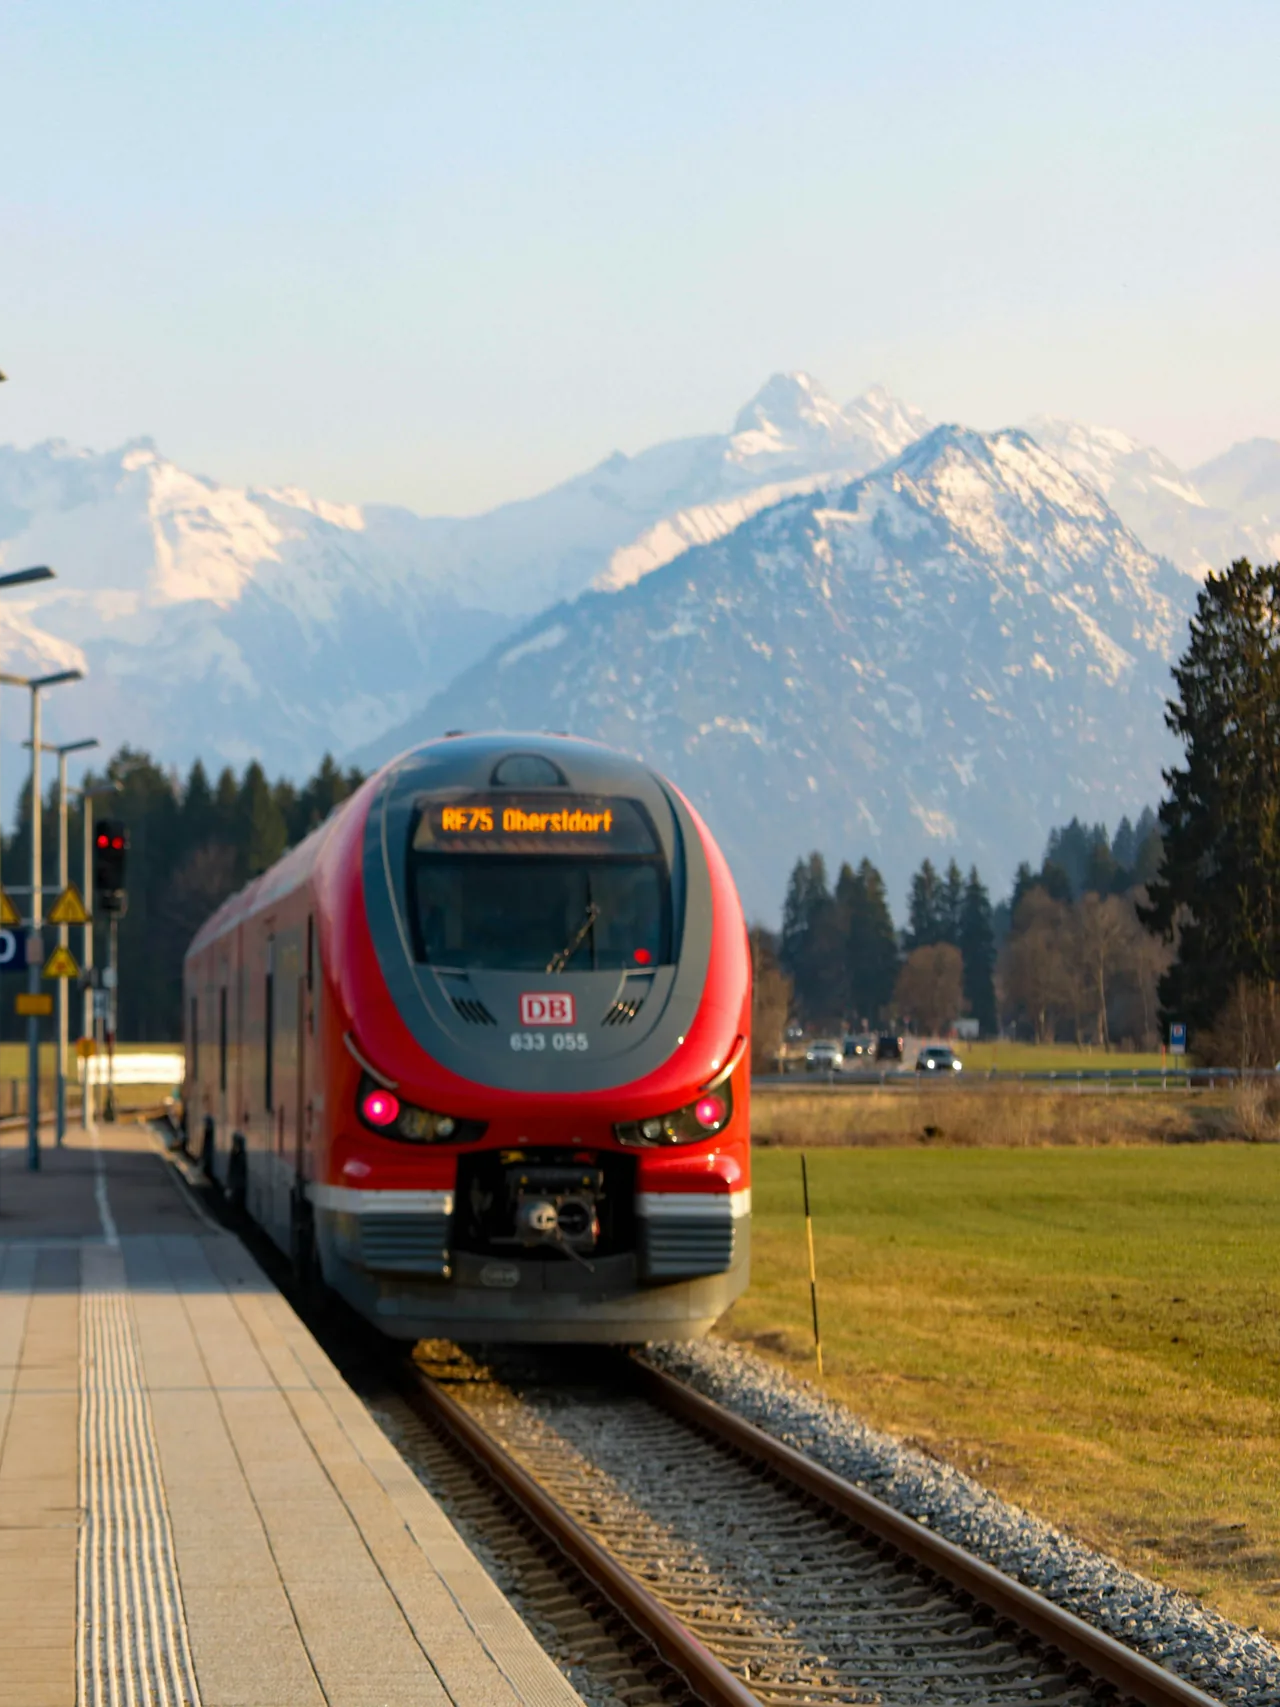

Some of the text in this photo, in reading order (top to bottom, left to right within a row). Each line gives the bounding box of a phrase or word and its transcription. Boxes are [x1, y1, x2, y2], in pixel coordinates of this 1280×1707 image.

[503, 808, 612, 832] Oberstdorf
[527, 999, 566, 1019] DB
[510, 1032, 588, 1051] 633 055
